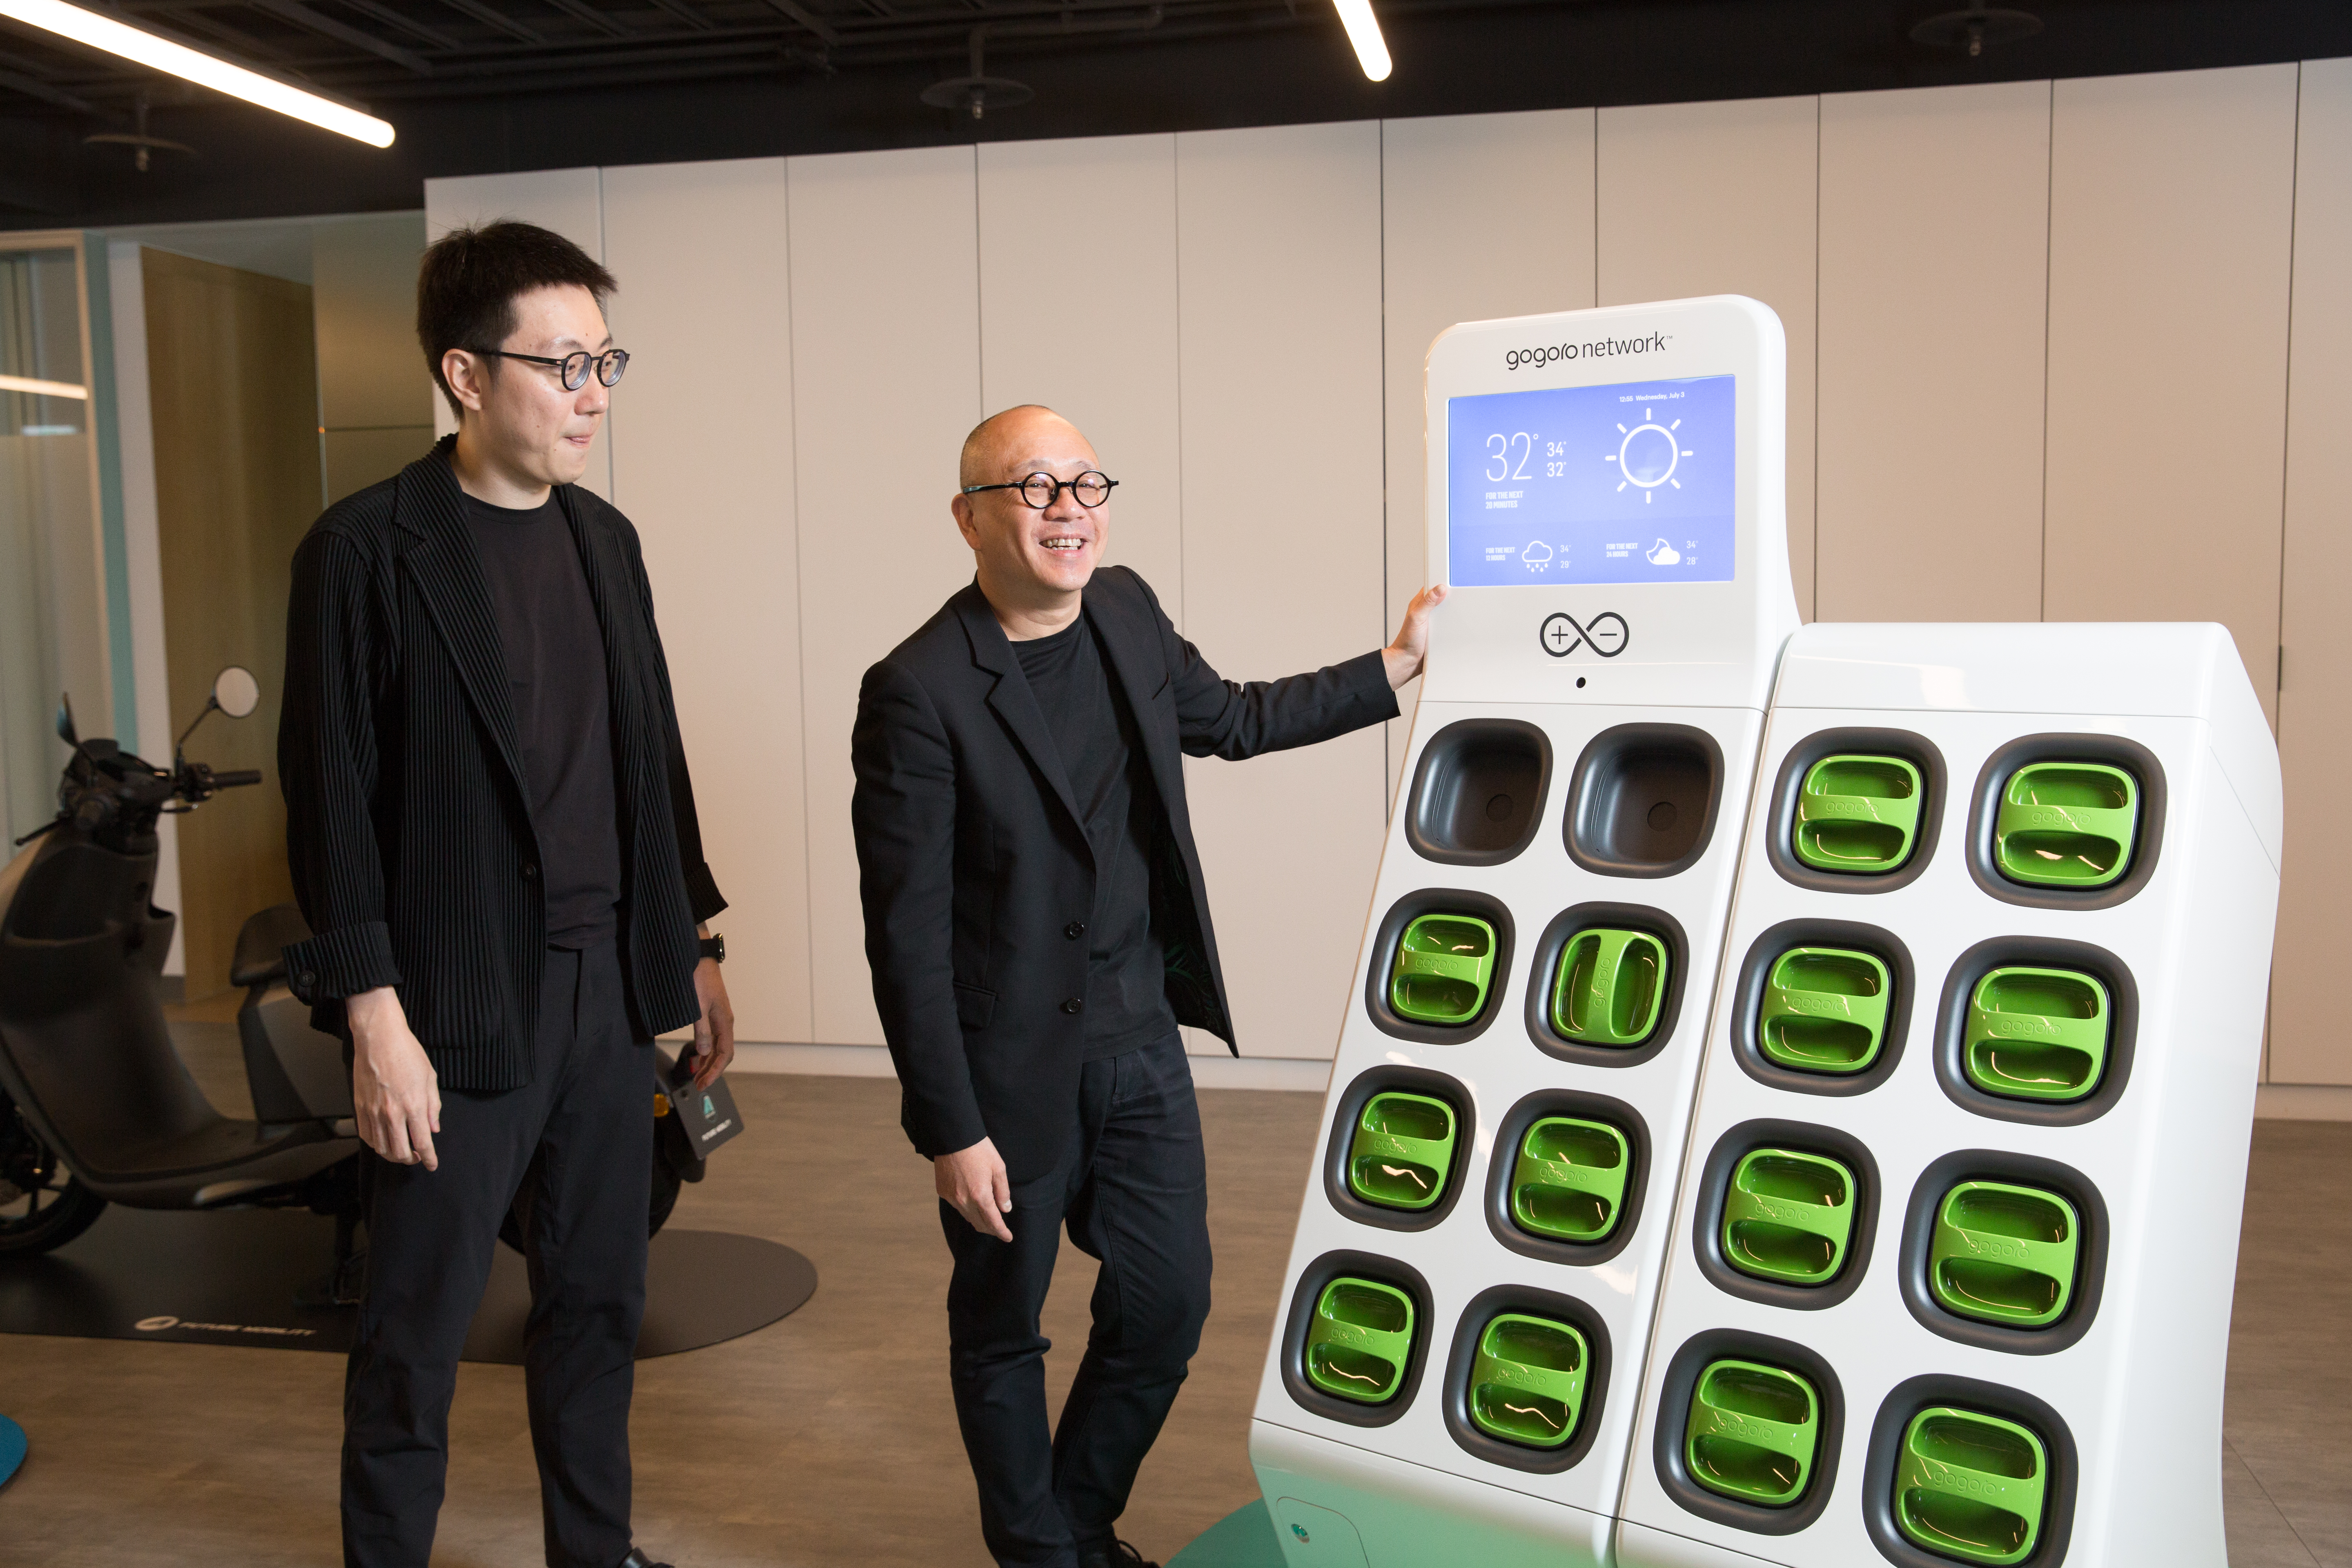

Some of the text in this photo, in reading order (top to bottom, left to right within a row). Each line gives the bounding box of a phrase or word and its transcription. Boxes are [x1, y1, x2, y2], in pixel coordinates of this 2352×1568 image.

[1506, 343, 1578, 370] gogoro
[1486, 432, 1539, 482] 32°
[1547, 441, 1566, 457] 34°
[1547, 461, 1566, 477] 32°
[1486, 492, 1497, 500] FOR
[1497, 491, 1508, 499] THE
[1493, 500, 1518, 509] MINUTES
[1826, 801, 1879, 815] gogoro
[2032, 811, 2091, 826] gogoro
[1416, 958, 1458, 971] gogoro
[1792, 997, 1846, 1012] gogoro
[2001, 1019, 2062, 1036] gogoro
[1374, 1139, 1417, 1153] gogoro
[1539, 1167, 1587, 1182] gogoro
[1755, 1203, 1810, 1221] gogoro
[1968, 1239, 2030, 1258] gogoro
[1331, 1327, 1375, 1345] gogoro
[1498, 1368, 1546, 1385] gogoro
[1719, 1418, 1773, 1438] gogoro
[1933, 1470, 1996, 1495] gogoro
